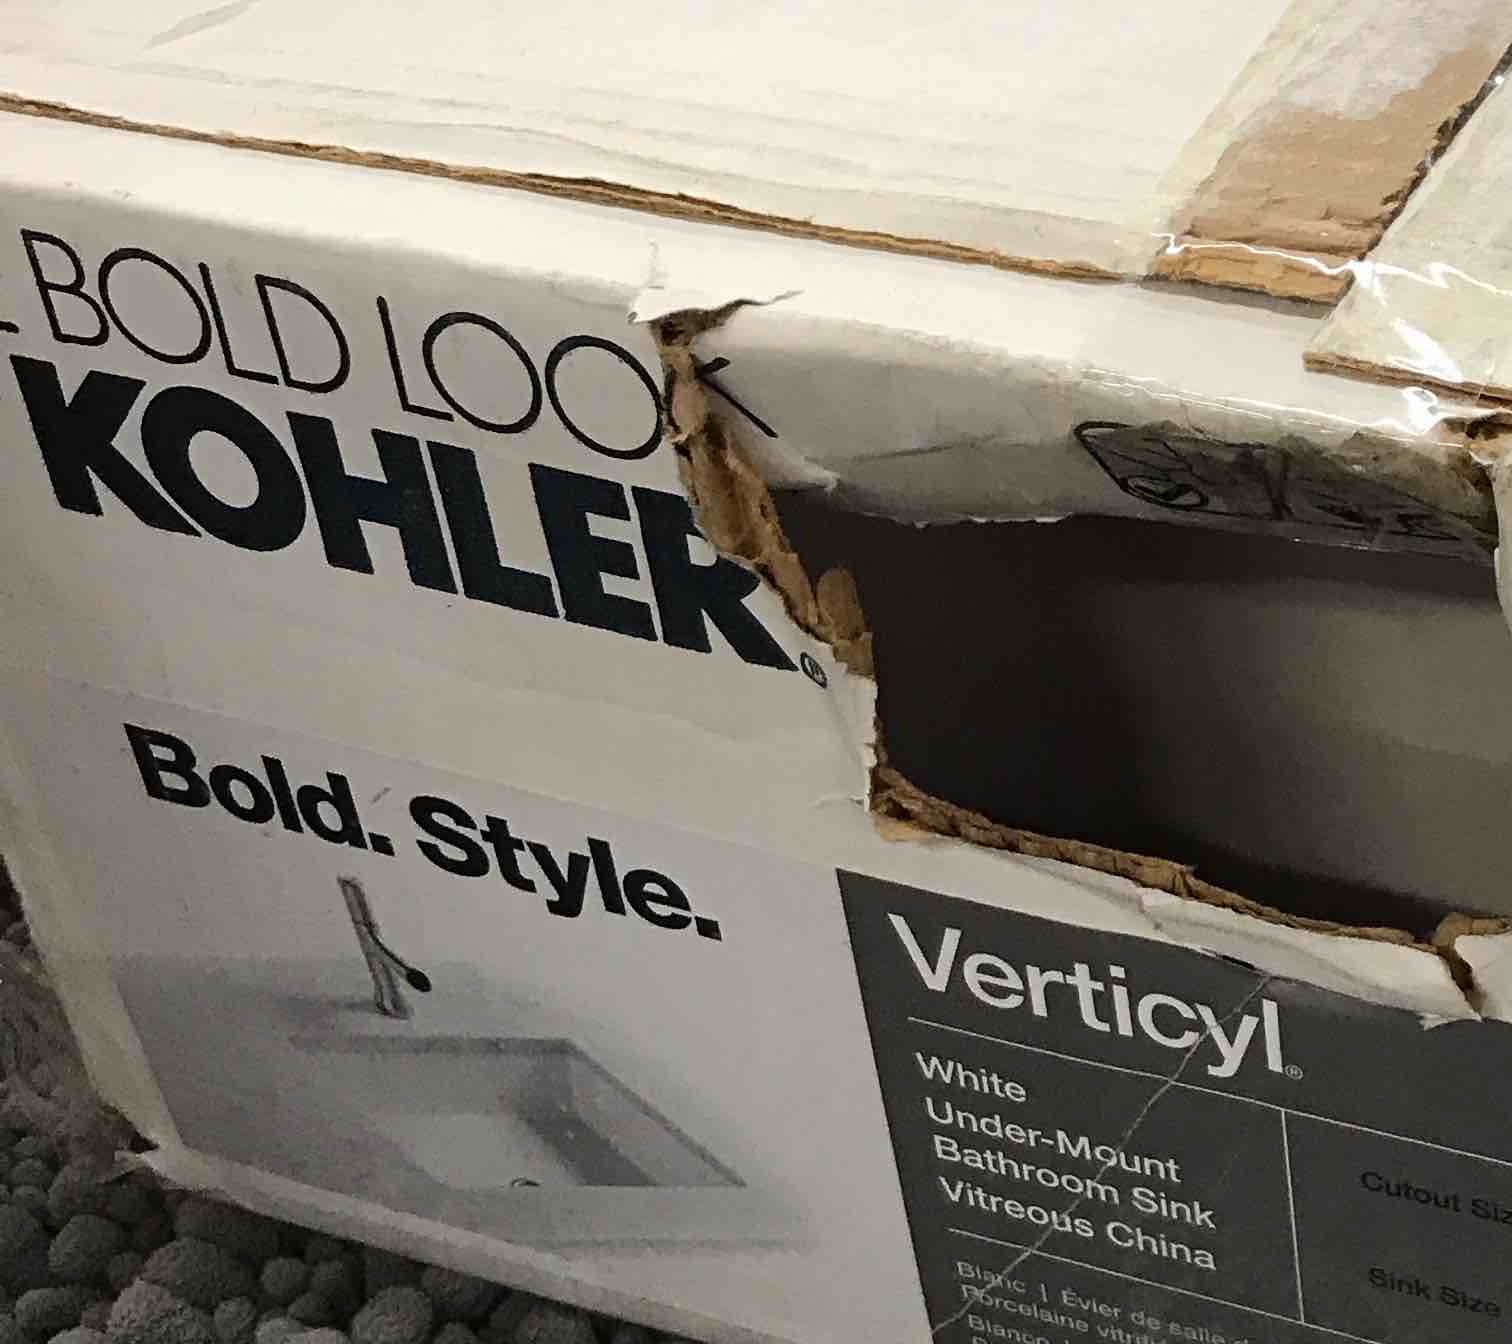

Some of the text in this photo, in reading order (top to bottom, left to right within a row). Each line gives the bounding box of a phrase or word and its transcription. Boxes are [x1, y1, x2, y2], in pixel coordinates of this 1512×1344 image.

[22, 228, 351, 394] BOLD
[123, 722, 722, 942] Bold. Style.
[914, 1051, 1027, 1103] White
[925, 1096, 1182, 1183] Under-Mount
[933, 1134, 1217, 1230] Bathroom Sink
[1359, 1170, 1461, 1212] Cutout
[940, 1176, 1216, 1270] Vitreous China
[957, 1261, 1026, 1292] Blanc
[1062, 1287, 1121, 1320] Évier
[1131, 1310, 1160, 1330] de
[961, 1284, 1089, 1332] Porcelaine
[1368, 1266, 1501, 1317] Sink Size
